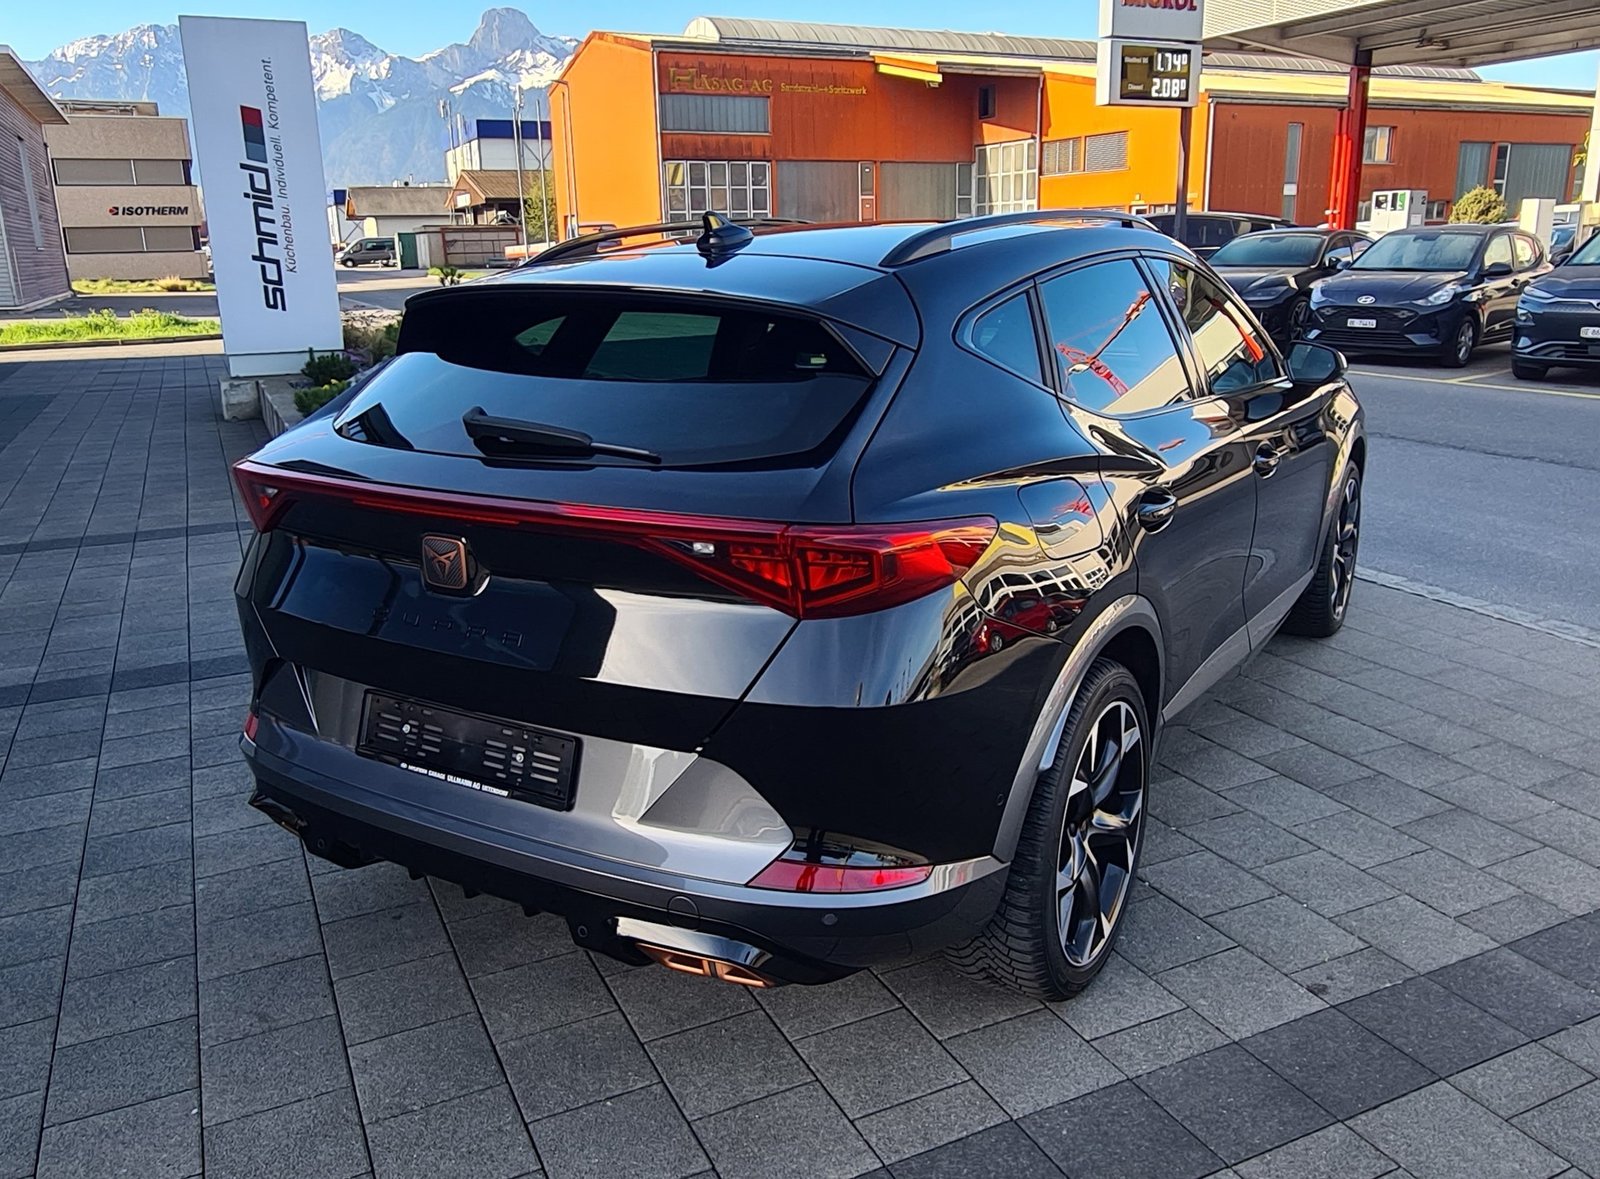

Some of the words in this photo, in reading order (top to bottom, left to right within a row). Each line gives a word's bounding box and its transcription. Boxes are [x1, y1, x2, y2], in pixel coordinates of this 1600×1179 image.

[261, 57, 280, 130] Kompetent.
[750, 78, 773, 92] AG
[269, 134, 289, 199] Individuell.
[121, 206, 189, 216] ISOTHERM
[239, 162, 287, 311] schmid
[280, 203, 297, 273] Küchenbau.
